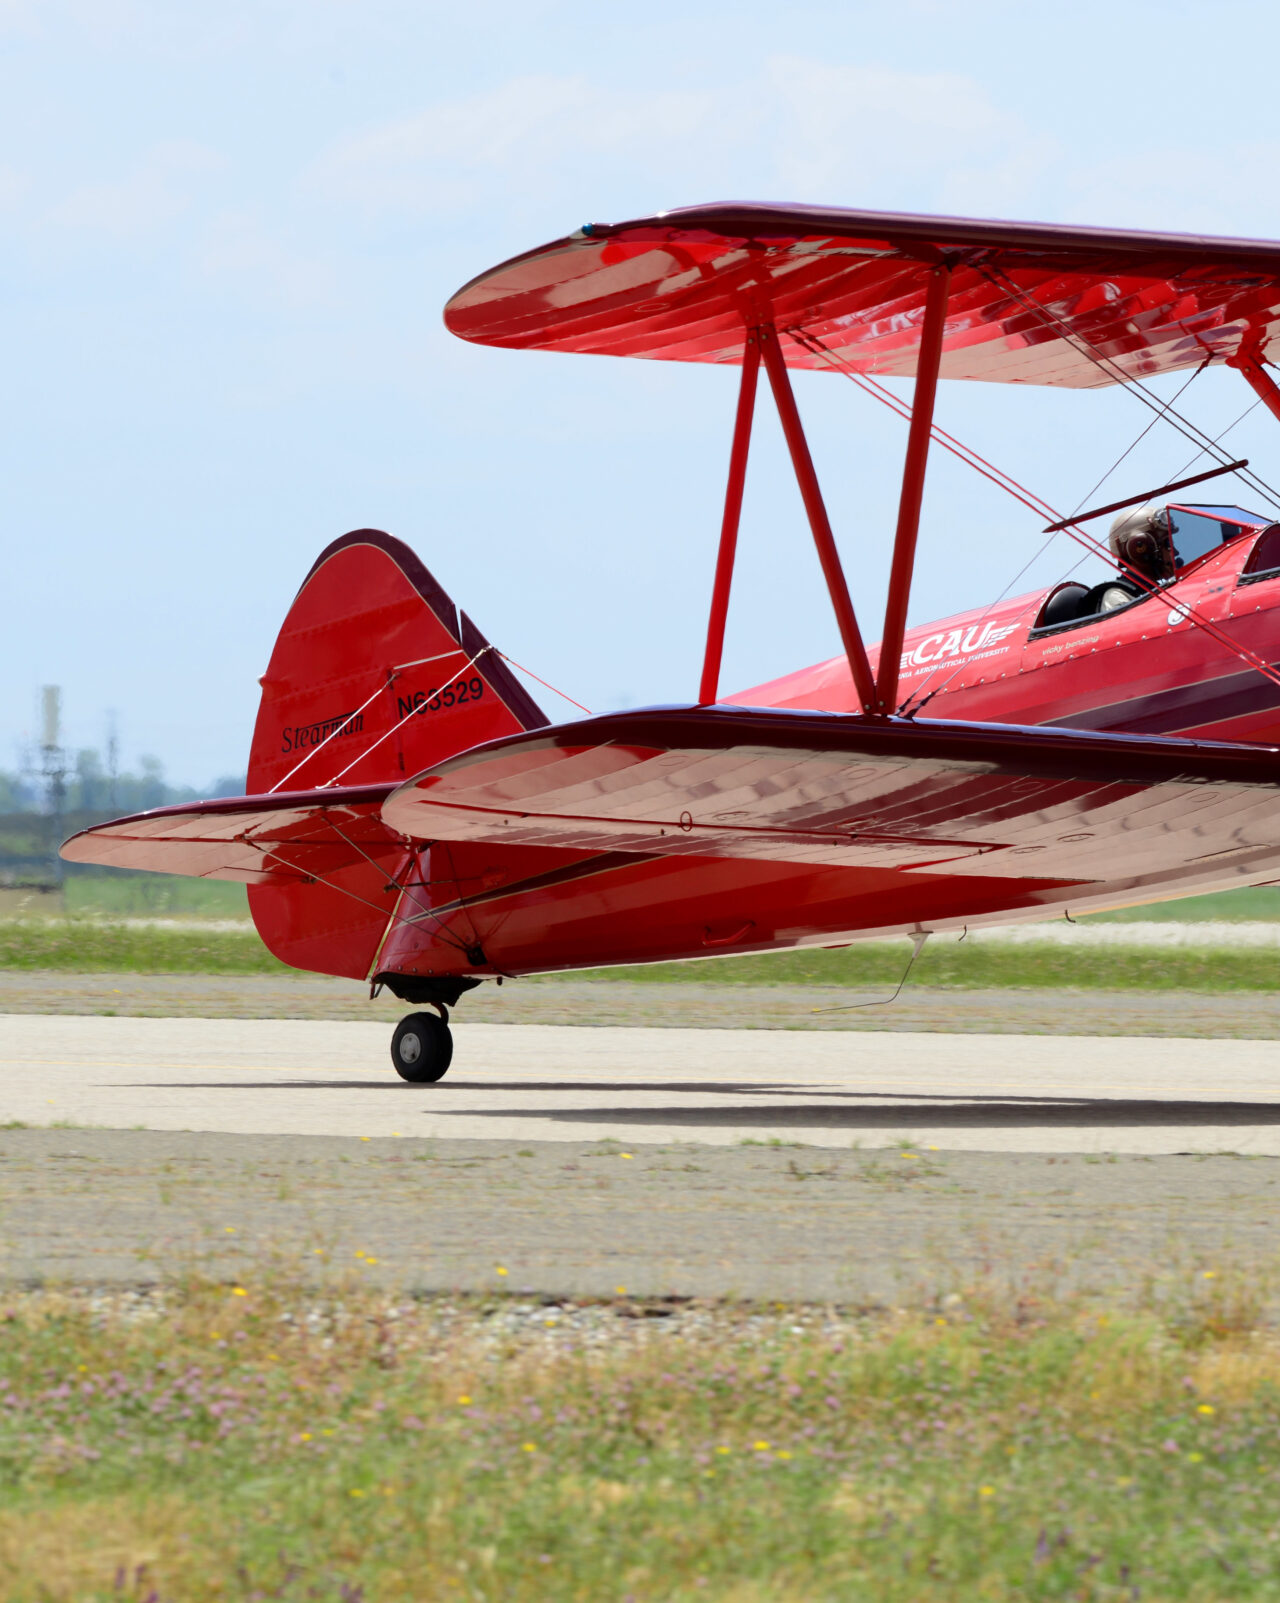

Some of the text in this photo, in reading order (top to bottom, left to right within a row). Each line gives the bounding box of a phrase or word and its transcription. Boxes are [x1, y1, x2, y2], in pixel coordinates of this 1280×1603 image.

[913, 620, 997, 665] CAU
[915, 657, 966, 675] AERONAUTICAL
[968, 646, 1010, 662] UNIVERSITY
[397, 677, 483, 720] N63529
[281, 708, 365, 754] Stearman
